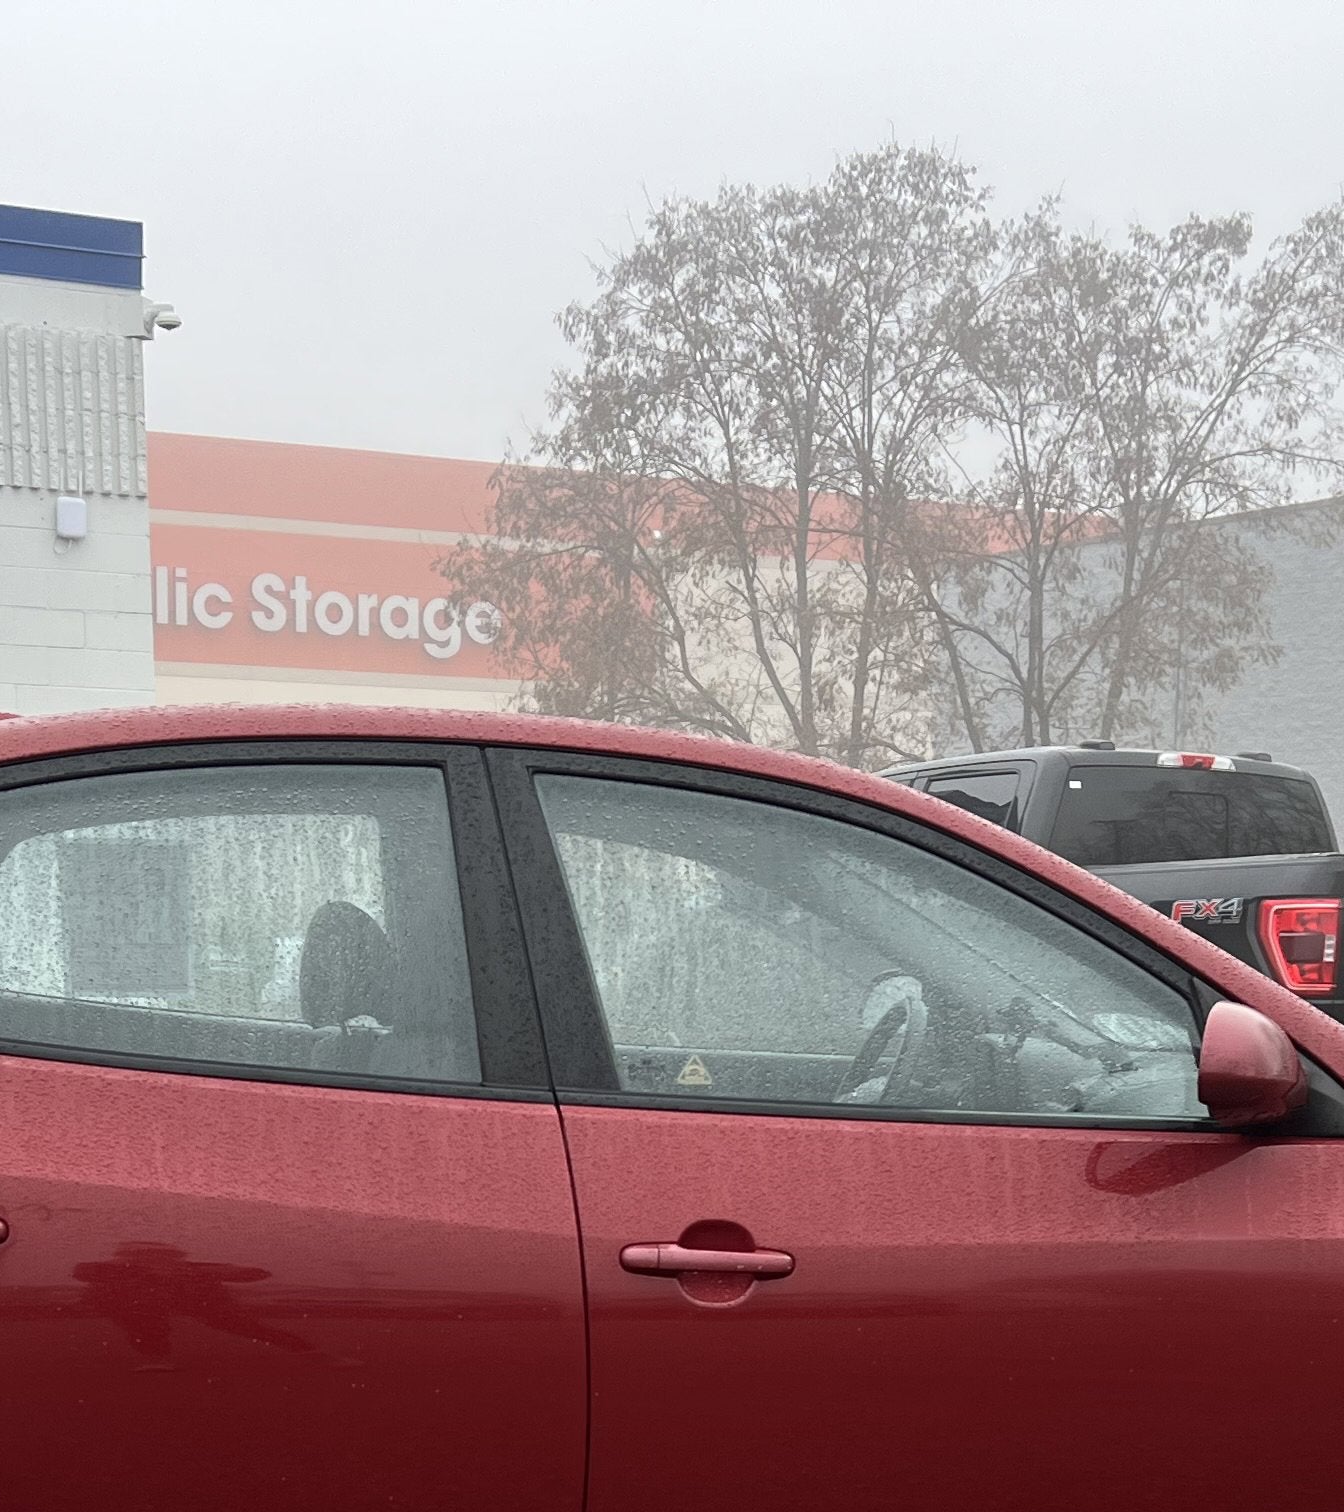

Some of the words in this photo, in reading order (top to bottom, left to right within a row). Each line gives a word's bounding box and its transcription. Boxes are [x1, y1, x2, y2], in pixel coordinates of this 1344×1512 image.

[155, 565, 234, 629] lic
[251, 573, 503, 659] Storage
[1171, 898, 1244, 923] FX4
